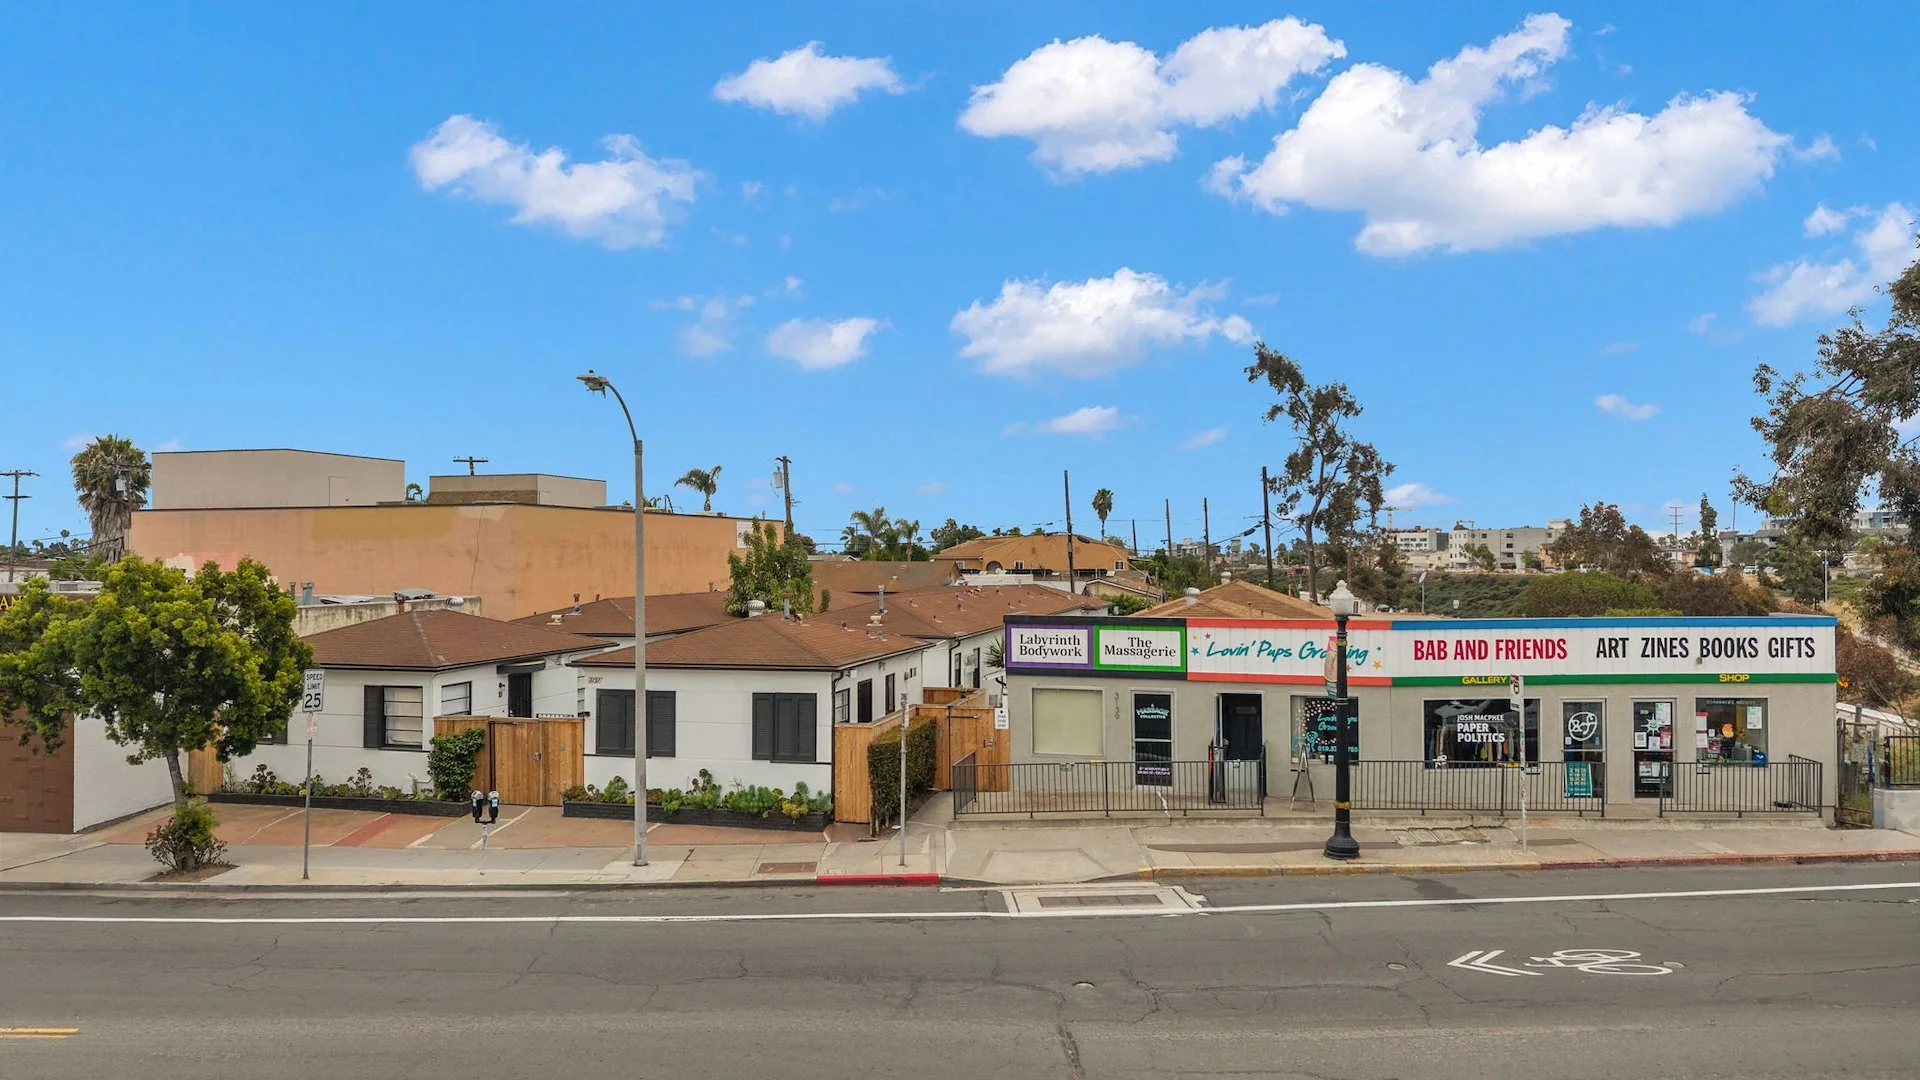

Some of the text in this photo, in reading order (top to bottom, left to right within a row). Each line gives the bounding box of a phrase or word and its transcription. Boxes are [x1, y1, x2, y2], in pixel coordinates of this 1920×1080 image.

[1020, 634, 1081, 655] Labyrinth
[1128, 637, 1153, 647] The
[1596, 637, 1816, 658] ART ZINES BOOKS GIFTS
[1020, 645, 1083, 658] Bodywork
[1104, 645, 1176, 659] Massagerie
[1207, 640, 1256, 657] Lovin'
[1257, 640, 1292, 662] Pups
[1414, 638, 1567, 660] BAB AND FRIENDS
[306, 673, 323, 681] SPEED
[1462, 676, 1507, 685] GALLERY
[1719, 674, 1750, 682] SHOP
[307, 682, 321, 690] LIMIT
[305, 693, 321, 708] 25
[1457, 714, 1473, 722] JOSH
[1457, 723, 1489, 733] PAPER
[1457, 732, 1505, 743] POLITICS
